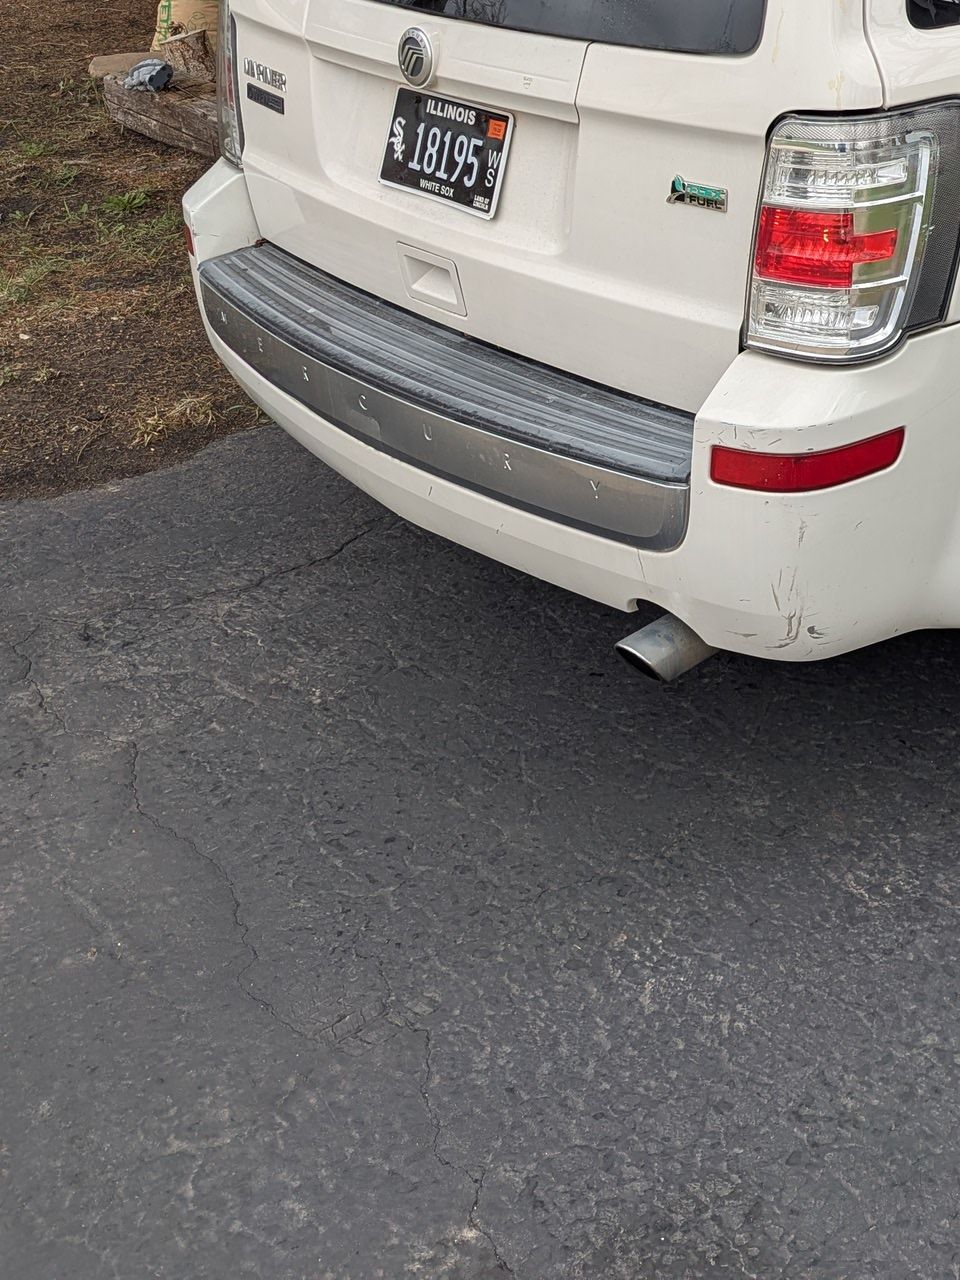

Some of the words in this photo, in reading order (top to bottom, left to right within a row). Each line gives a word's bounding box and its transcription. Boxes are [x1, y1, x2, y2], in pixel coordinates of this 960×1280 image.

[426, 99, 477, 125] ILLINOIS
[407, 122, 484, 188] 18195
[420, 178, 440, 194] WHITE
[440, 184, 454, 198] SOX
[689, 195, 722, 209] FUEL
[219, 310, 601, 500] MERCURY
